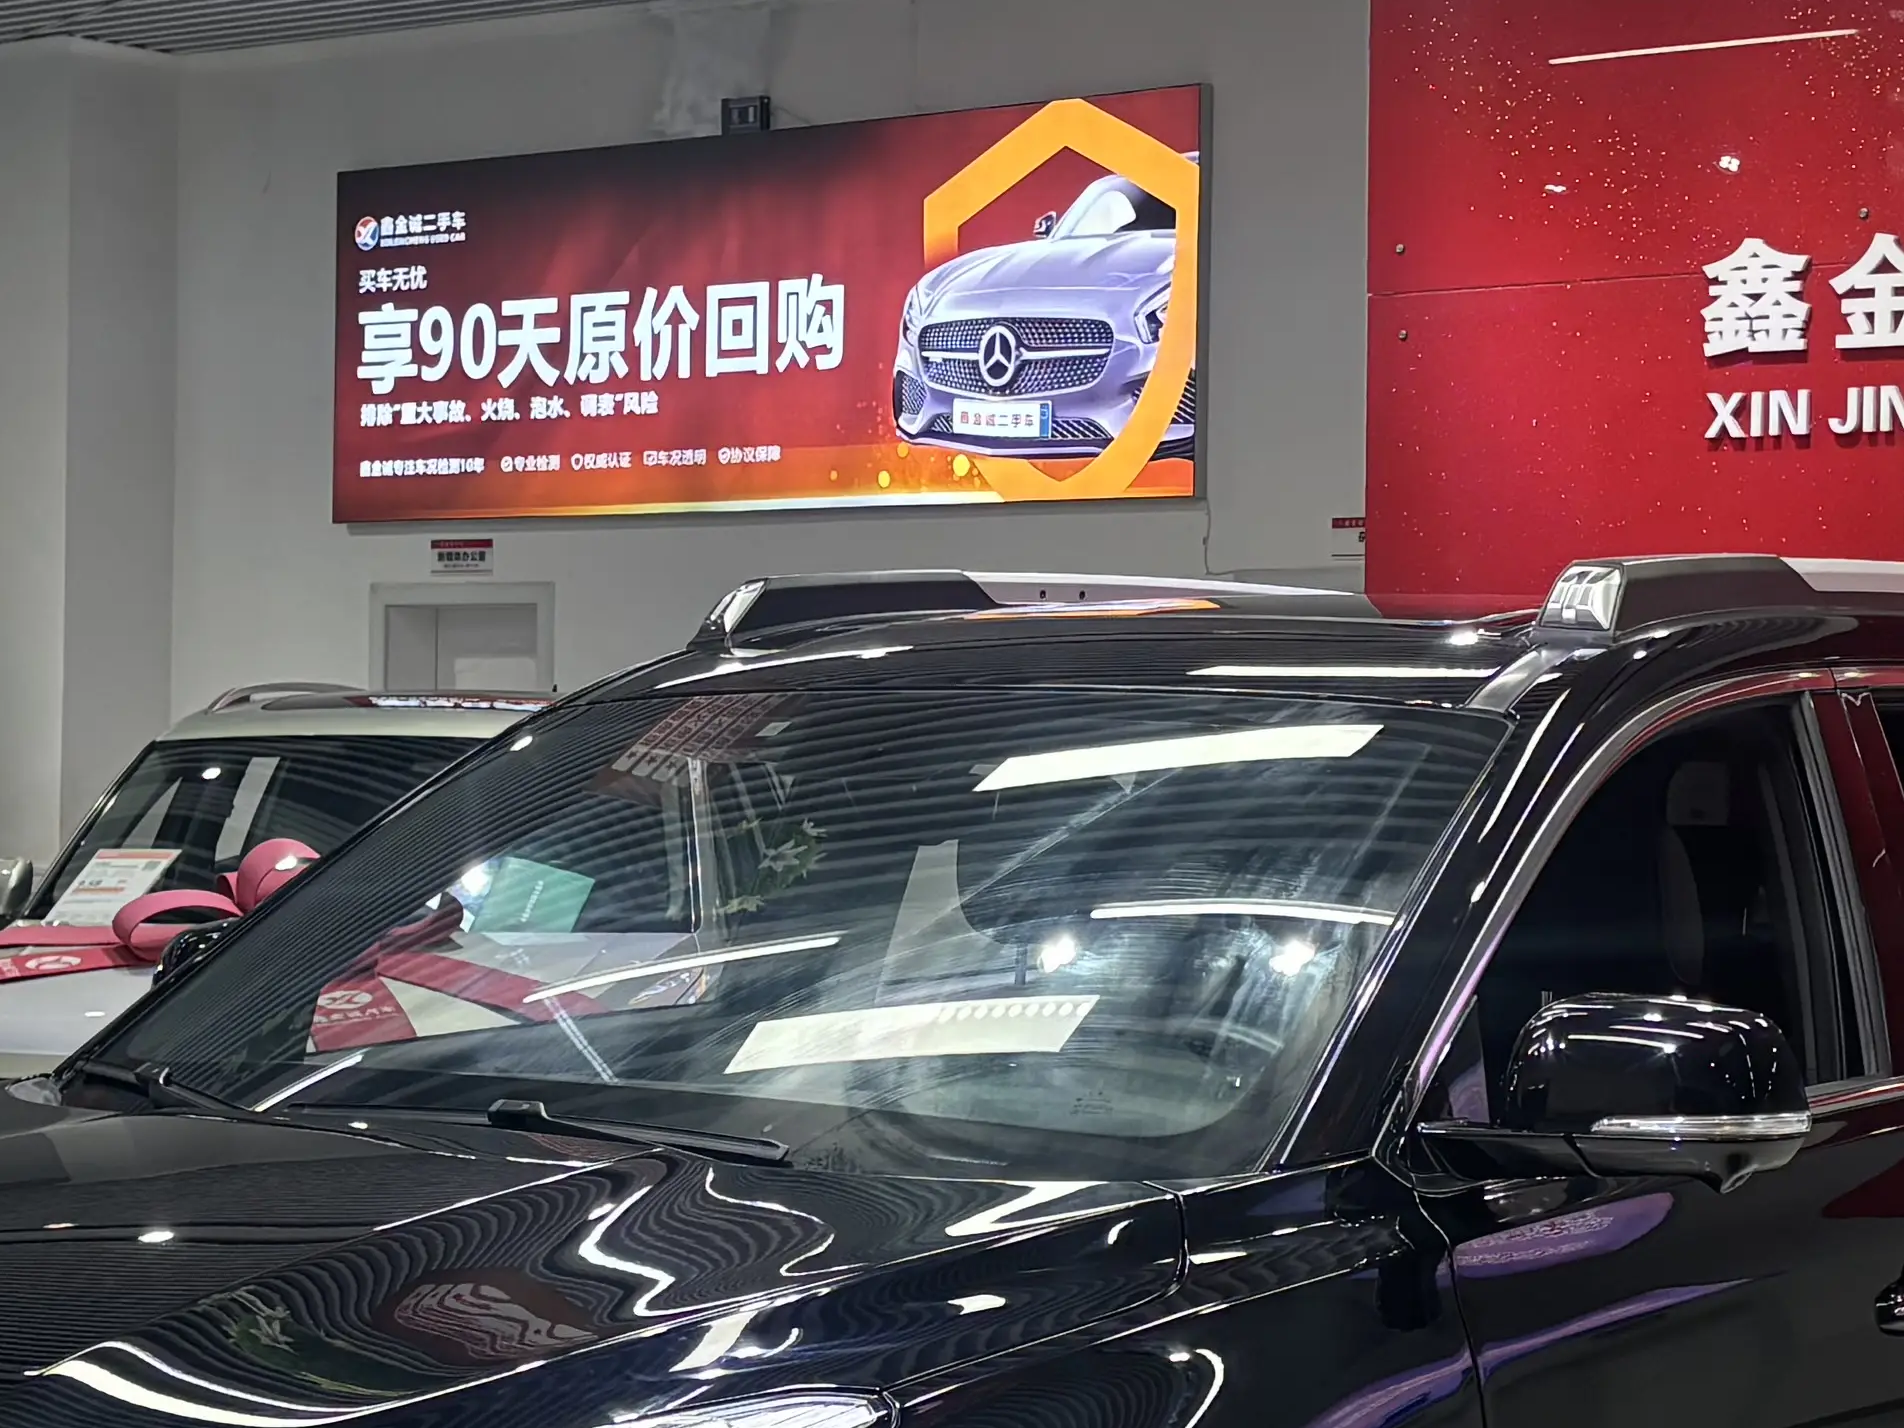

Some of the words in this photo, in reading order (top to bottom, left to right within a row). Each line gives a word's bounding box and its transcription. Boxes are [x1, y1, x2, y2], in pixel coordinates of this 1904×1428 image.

[359, 265, 428, 294] 买车无忧
[357, 273, 845, 395] 享90天原价回购
[1706, 388, 1812, 440] XIN
